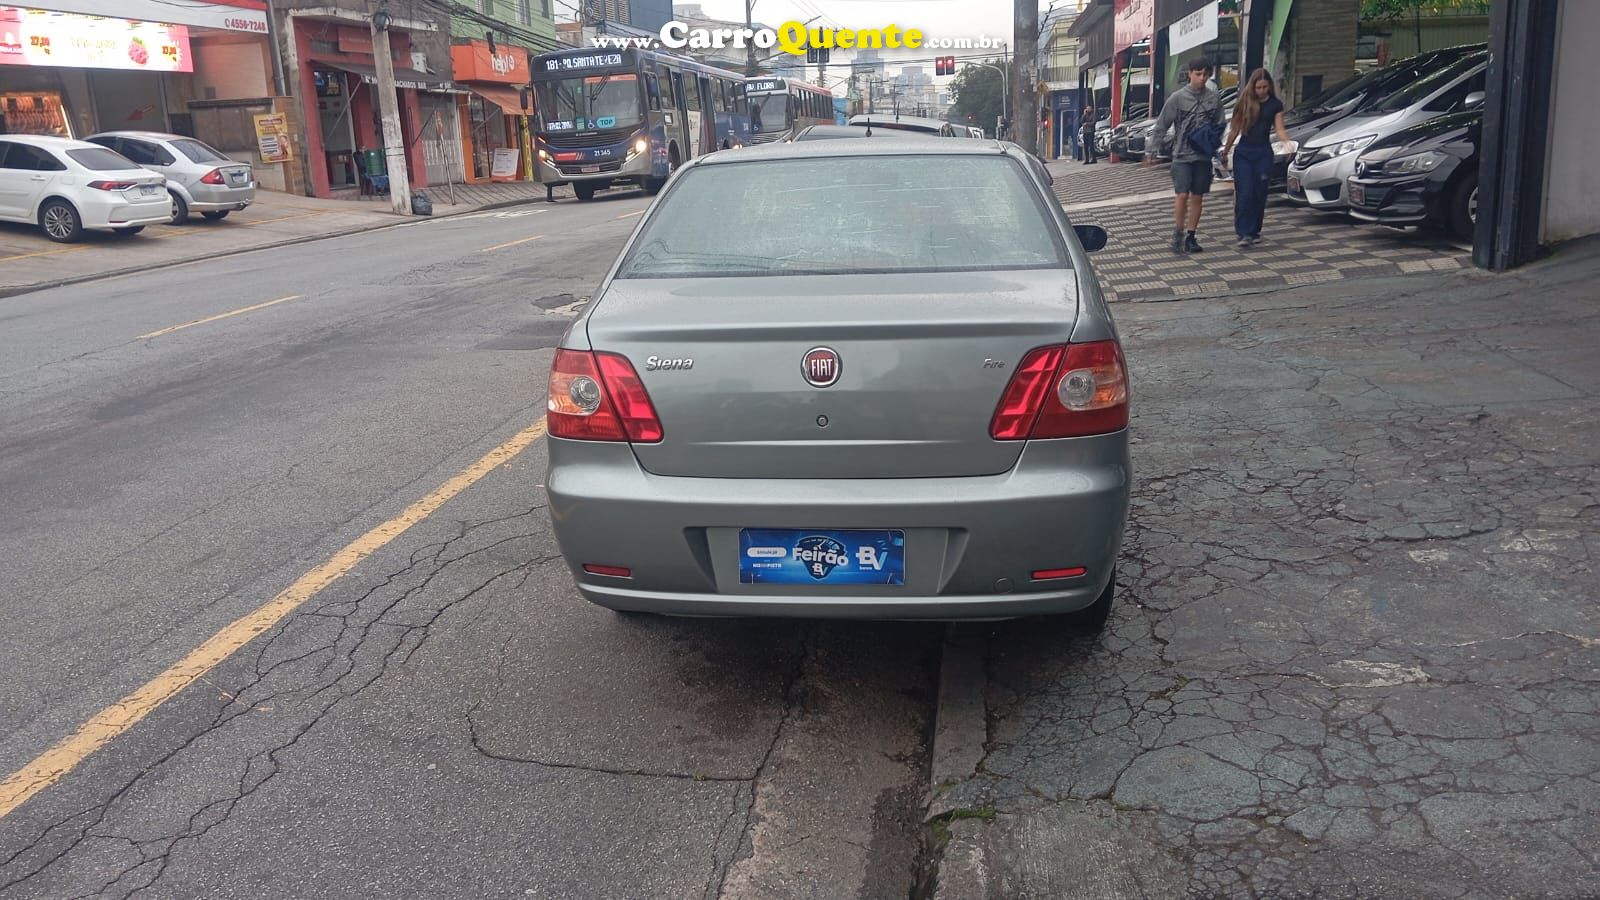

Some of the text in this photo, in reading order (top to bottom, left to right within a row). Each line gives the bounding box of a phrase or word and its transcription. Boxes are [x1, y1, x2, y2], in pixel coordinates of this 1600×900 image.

[646, 355, 694, 372] Siena
[811, 358, 833, 377] FIAT
[983, 358, 1006, 369] Fire
[792, 545, 849, 568] Feirão
